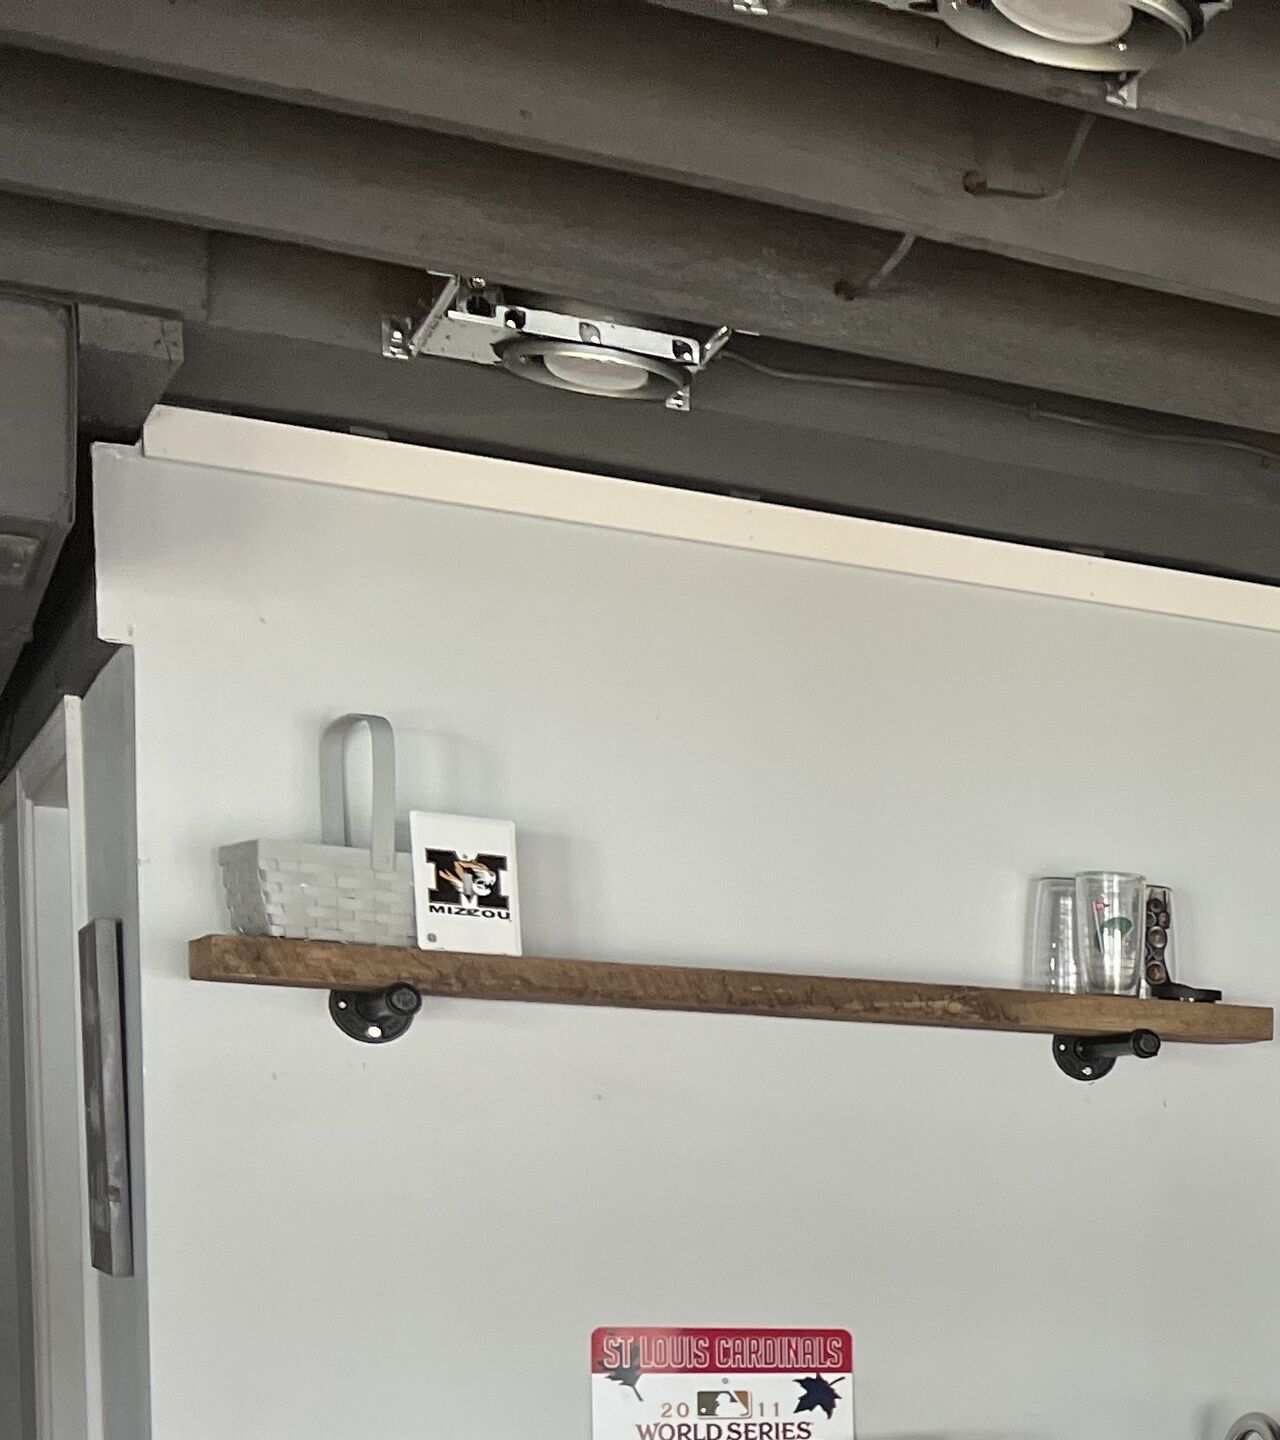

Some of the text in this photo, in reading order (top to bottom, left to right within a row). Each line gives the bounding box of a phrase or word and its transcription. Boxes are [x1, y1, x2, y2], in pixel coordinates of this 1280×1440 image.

[639, 1335, 710, 1369] LOUIS
[715, 1335, 843, 1369] CARDINALS
[660, 1402, 780, 1418] 20 11
[726, 1421, 813, 1440] SERIES
